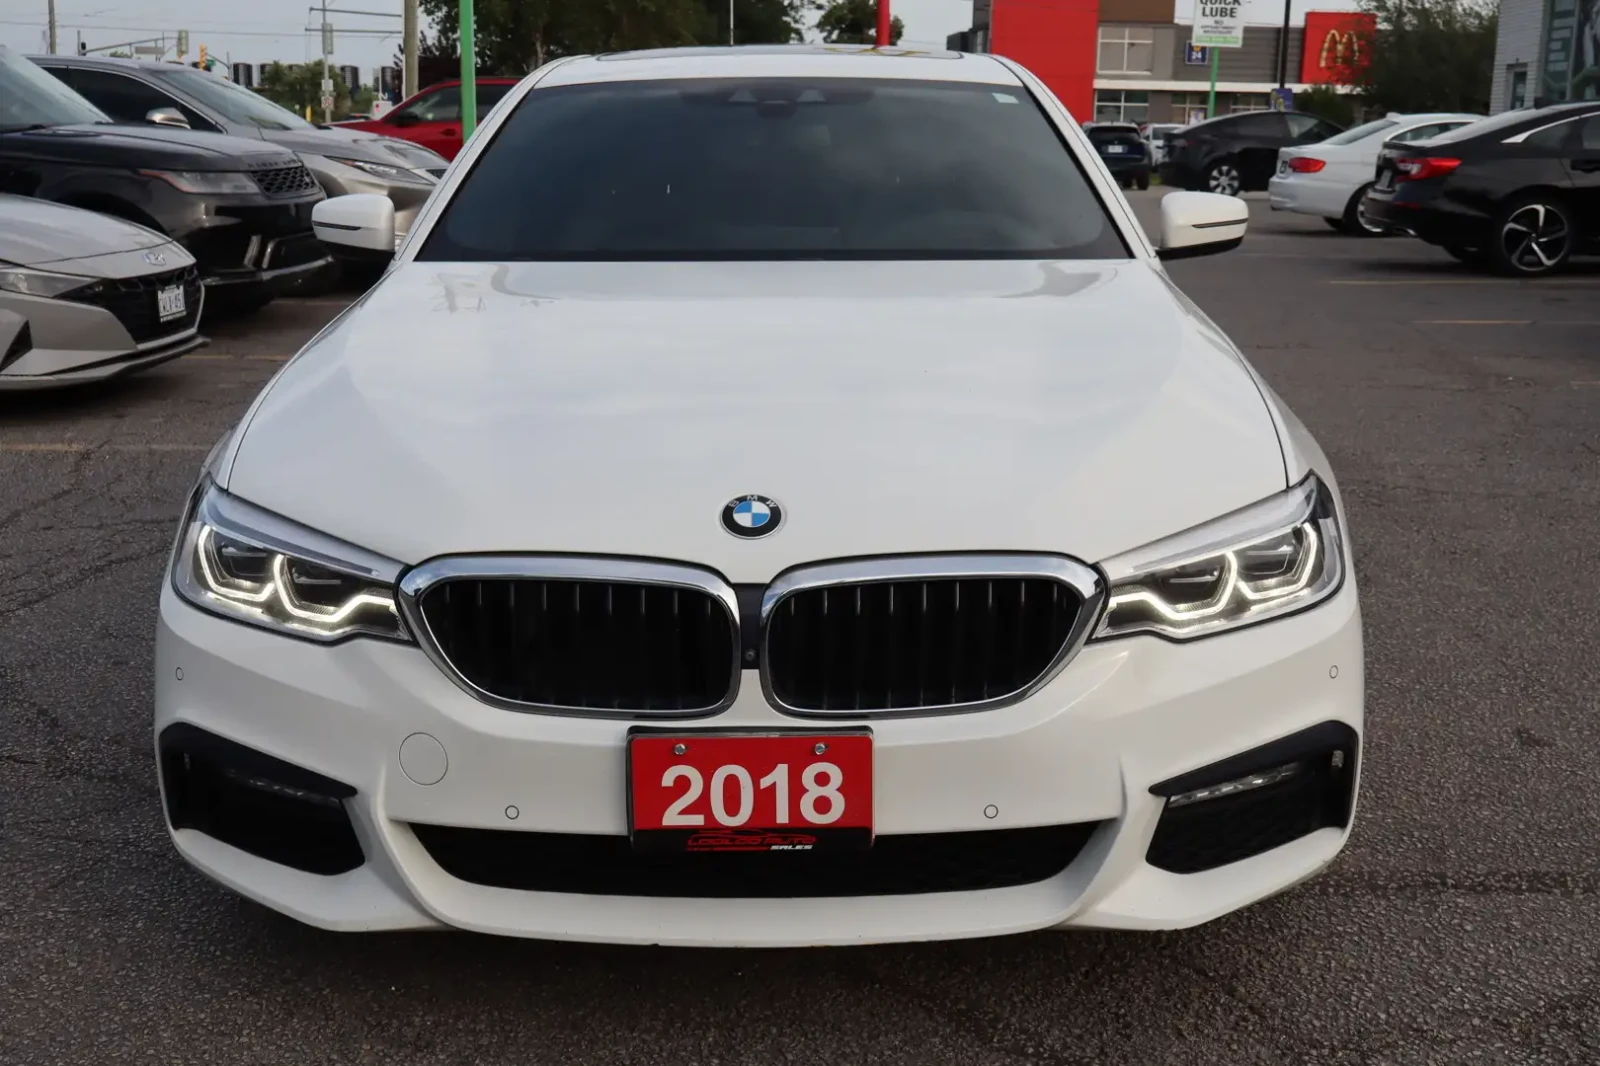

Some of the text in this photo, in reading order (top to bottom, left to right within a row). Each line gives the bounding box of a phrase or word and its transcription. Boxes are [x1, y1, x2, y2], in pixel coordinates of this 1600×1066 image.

[1202, 6, 1237, 18] LUBE
[727, 494, 777, 508] BMW
[661, 762, 845, 826] 2018
